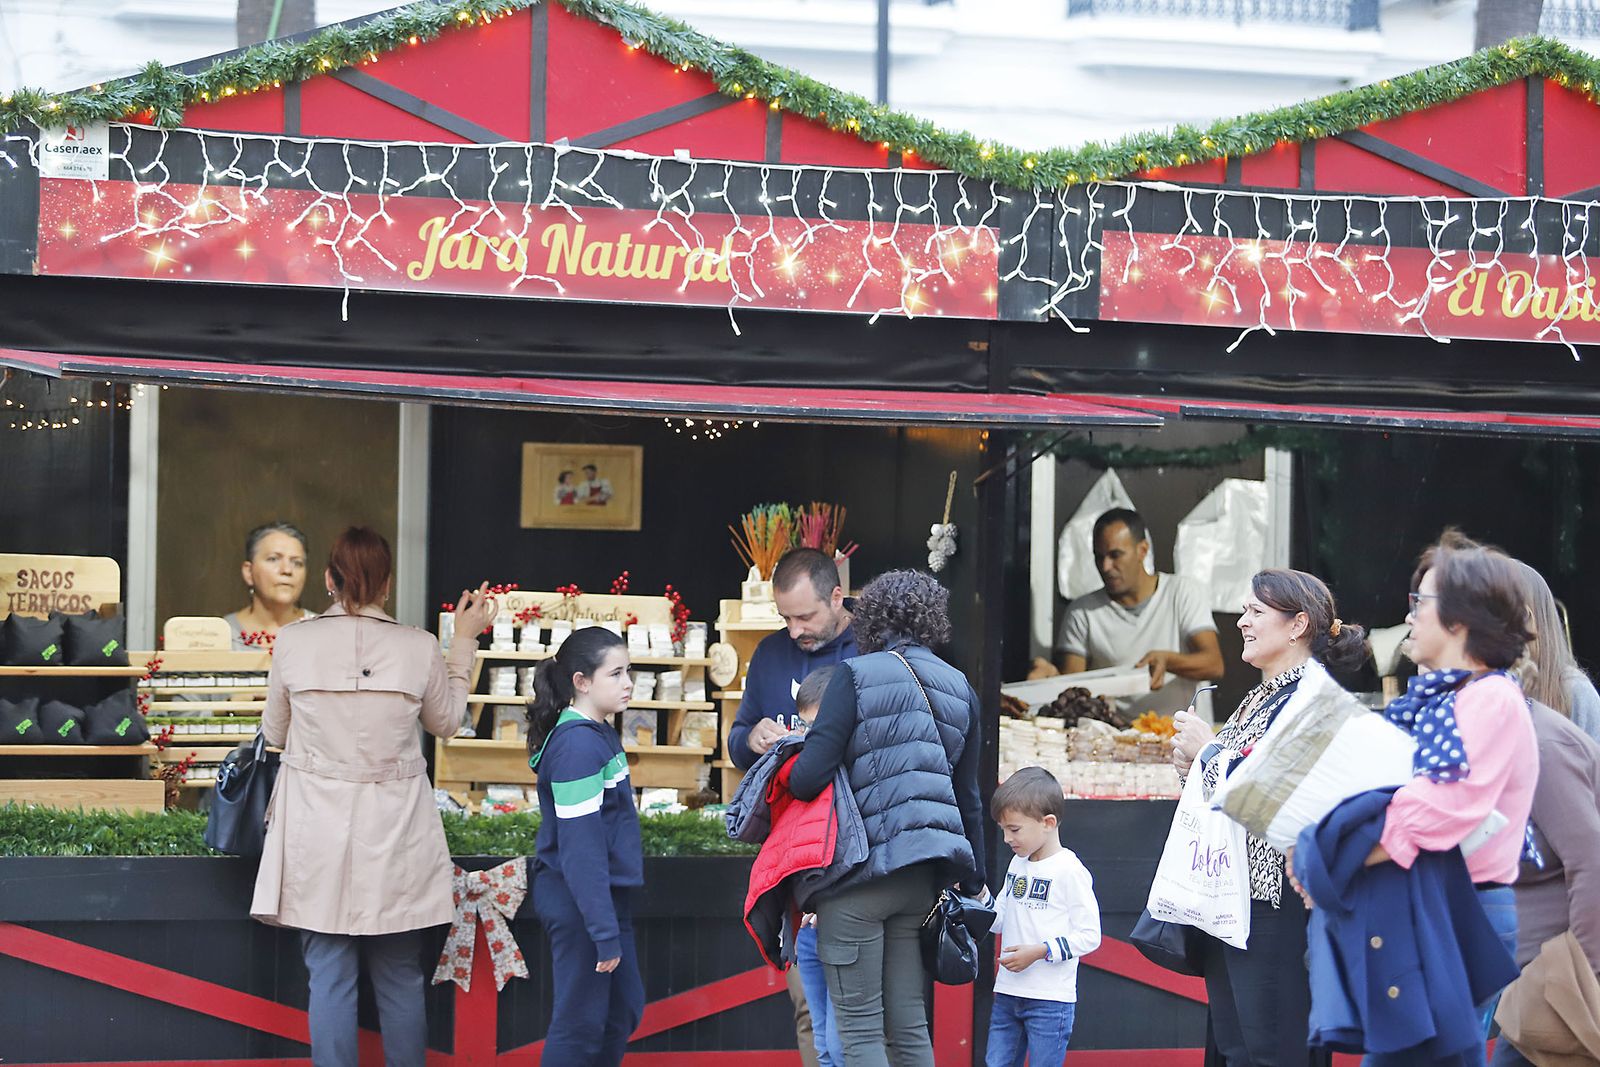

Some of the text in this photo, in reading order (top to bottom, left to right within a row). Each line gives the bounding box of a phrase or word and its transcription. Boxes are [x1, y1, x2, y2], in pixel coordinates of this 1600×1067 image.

[406, 216, 734, 284] Jara Natural
[1447, 267, 1489, 317] El
[16, 568, 75, 590] SACOS
